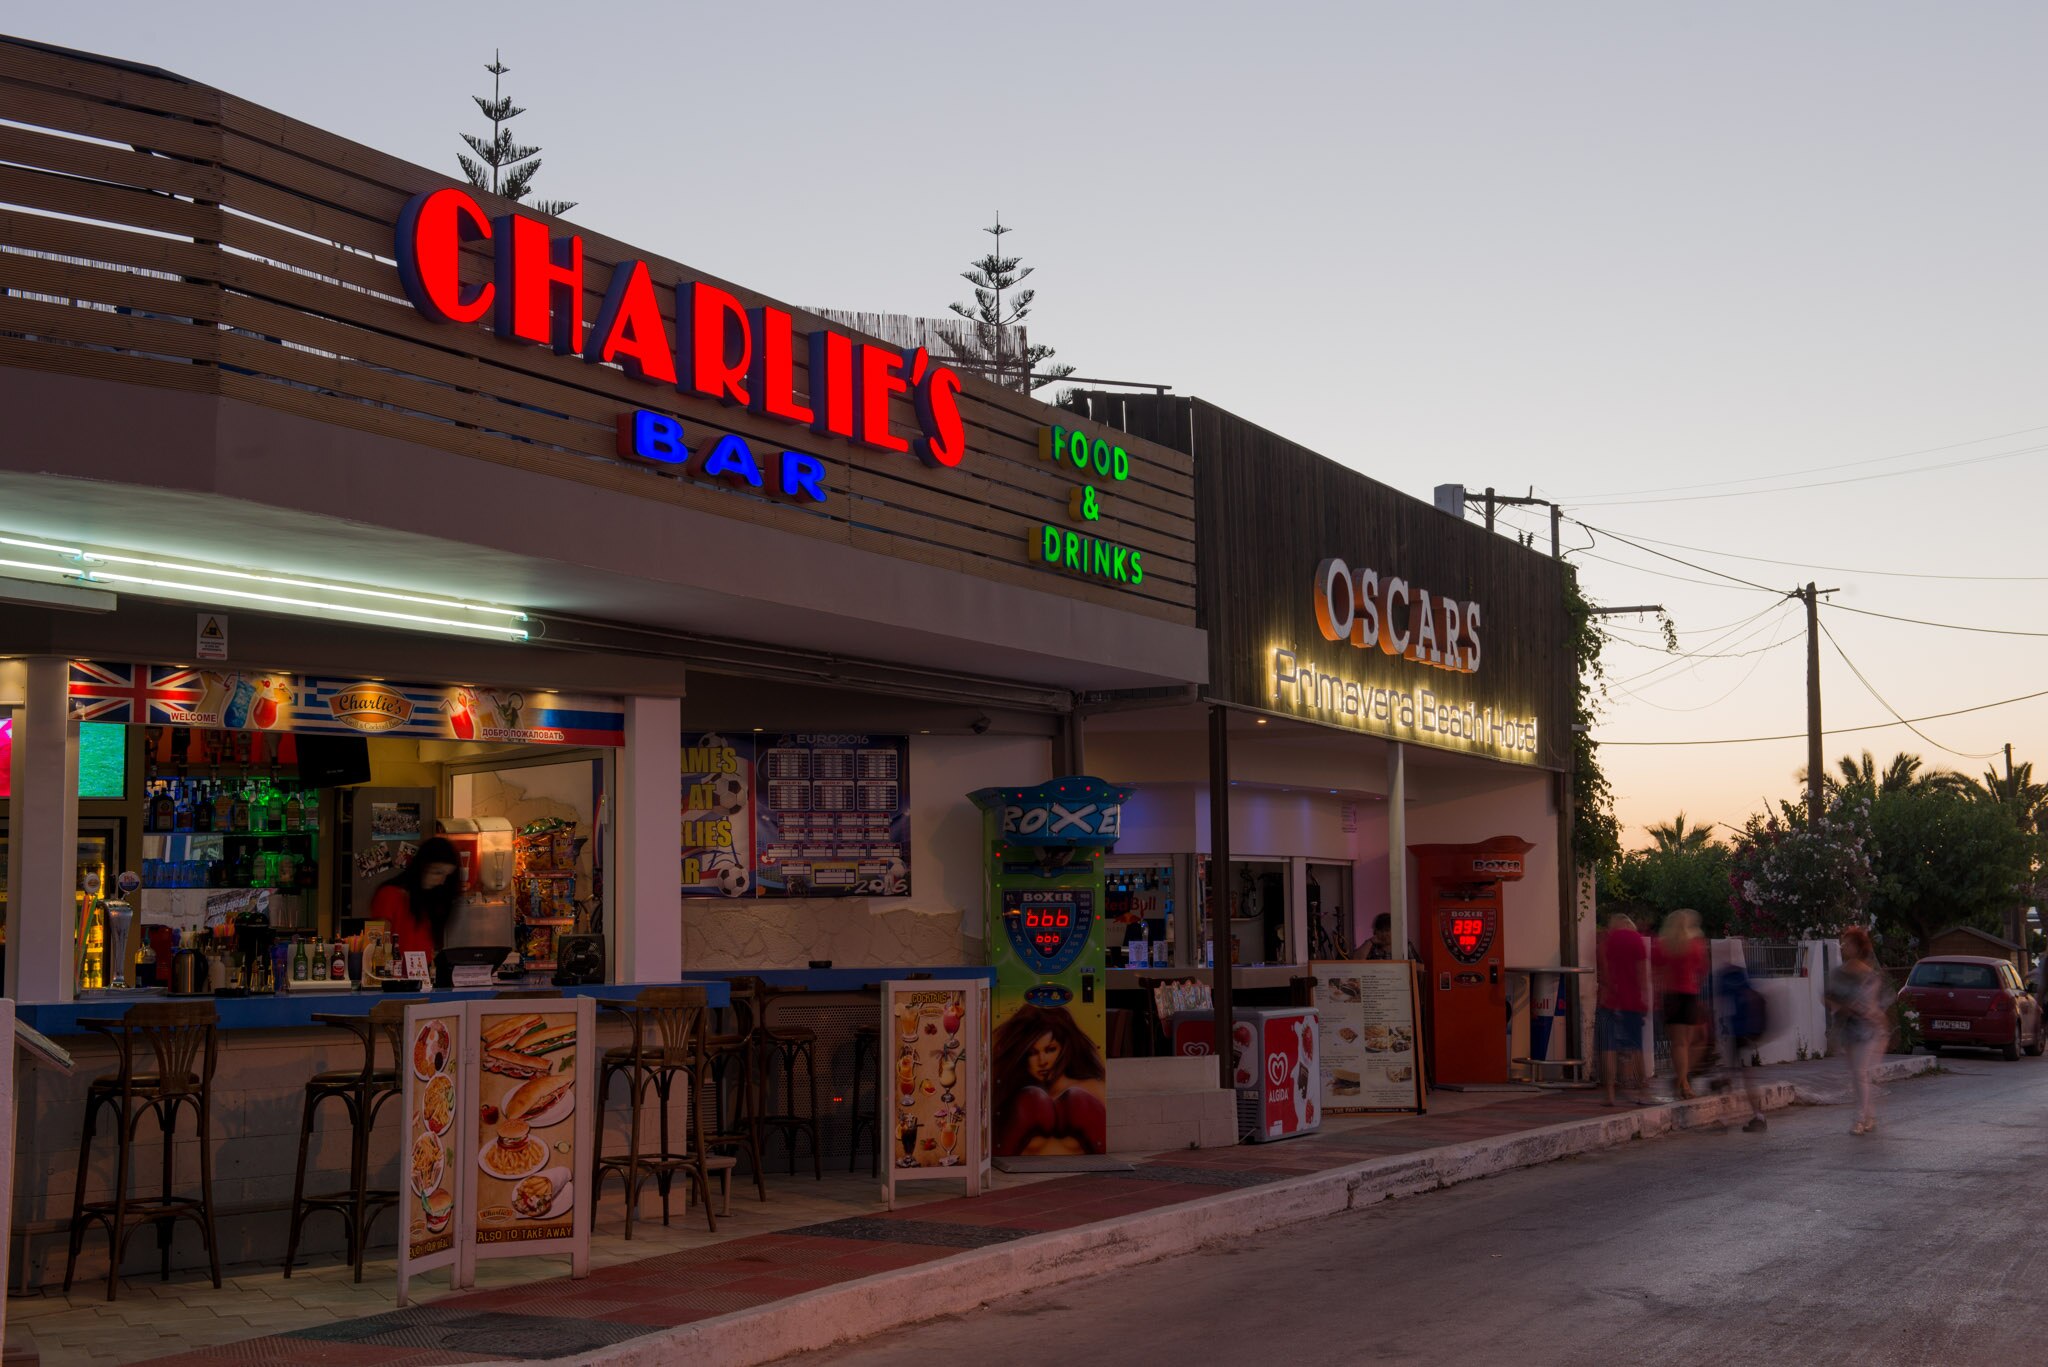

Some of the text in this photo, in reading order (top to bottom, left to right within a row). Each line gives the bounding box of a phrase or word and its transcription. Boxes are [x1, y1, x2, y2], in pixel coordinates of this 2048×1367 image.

[398, 188, 965, 468] CHARLIE'S
[622, 409, 827, 503] BAR
[1052, 424, 1129, 481] FOOD
[1081, 485, 1099, 521] &
[1042, 525, 1144, 585] DRINKS
[1315, 558, 1481, 673] OSCARS
[339, 691, 403, 715] Charlie's
[1274, 648, 1539, 754] Primavera Beach Hotel
[171, 711, 217, 723] WELCOME
[482, 728, 565, 740] ДОБРО ПОЖАЛОВАТЬ
[688, 784, 717, 810] AT
[912, 992, 948, 1003] COCKTAILS
[1268, 1088, 1289, 1103] ALGIDA
[477, 1226, 572, 1243] ALSO TO TAKE AWAY
